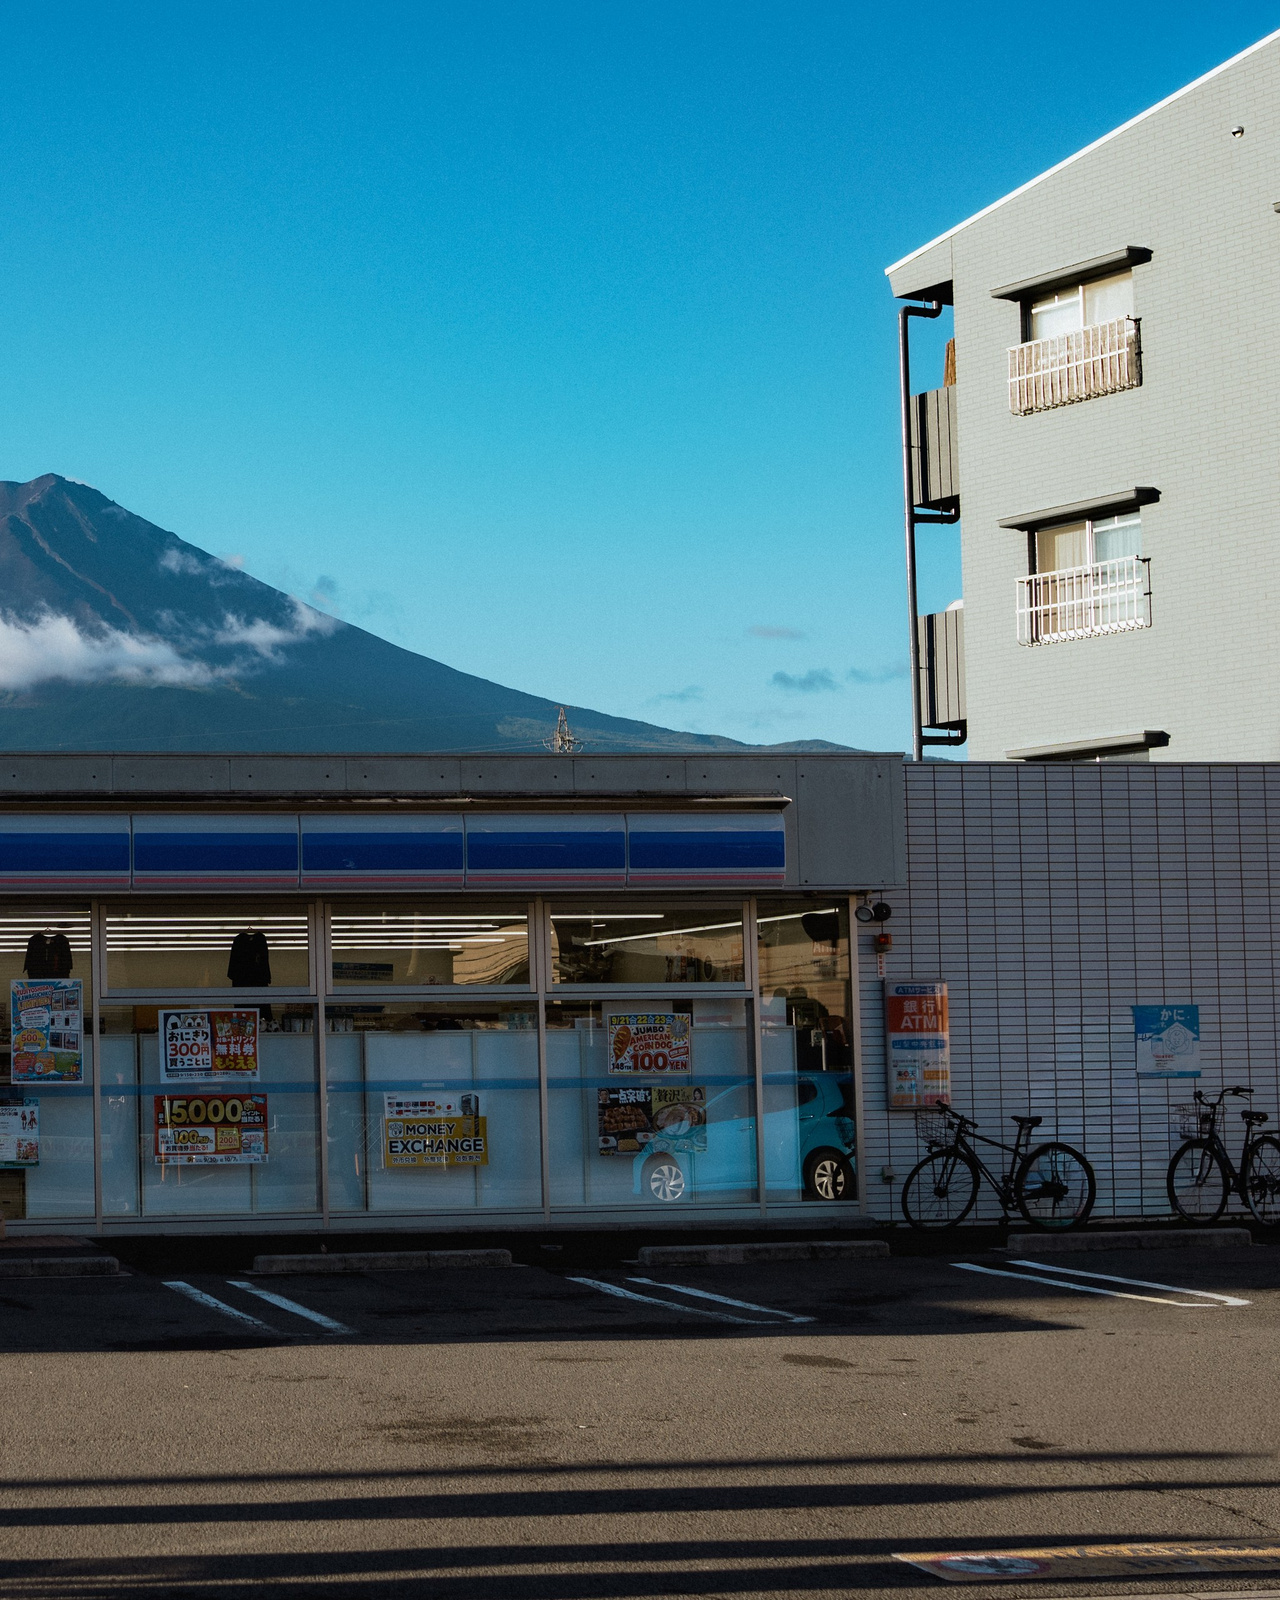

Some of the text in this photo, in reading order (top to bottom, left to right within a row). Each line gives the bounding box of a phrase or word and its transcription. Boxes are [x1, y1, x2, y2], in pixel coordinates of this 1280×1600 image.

[903, 1000, 935, 1013] 銀行
[612, 1016, 630, 1025] 9/21
[637, 1016, 648, 1024] 22
[654, 1015, 666, 1024] 23
[900, 1015, 938, 1029] ATM
[168, 1030, 209, 1042] おにぎり
[633, 1026, 665, 1036] JUMBO
[630, 1033, 671, 1046] AMERICAN
[169, 1043, 210, 1057] 300円
[216, 1043, 255, 1056] 無料券
[633, 1041, 672, 1052] CORN DOG
[169, 1058, 210, 1067] 買うごとに
[216, 1056, 257, 1070] もらえる
[630, 1052, 668, 1071] 100
[669, 1061, 687, 1070] YEN
[163, 1098, 244, 1124] 15,000
[405, 1123, 456, 1135] MONEY
[389, 1139, 484, 1154] EXCHANGE
